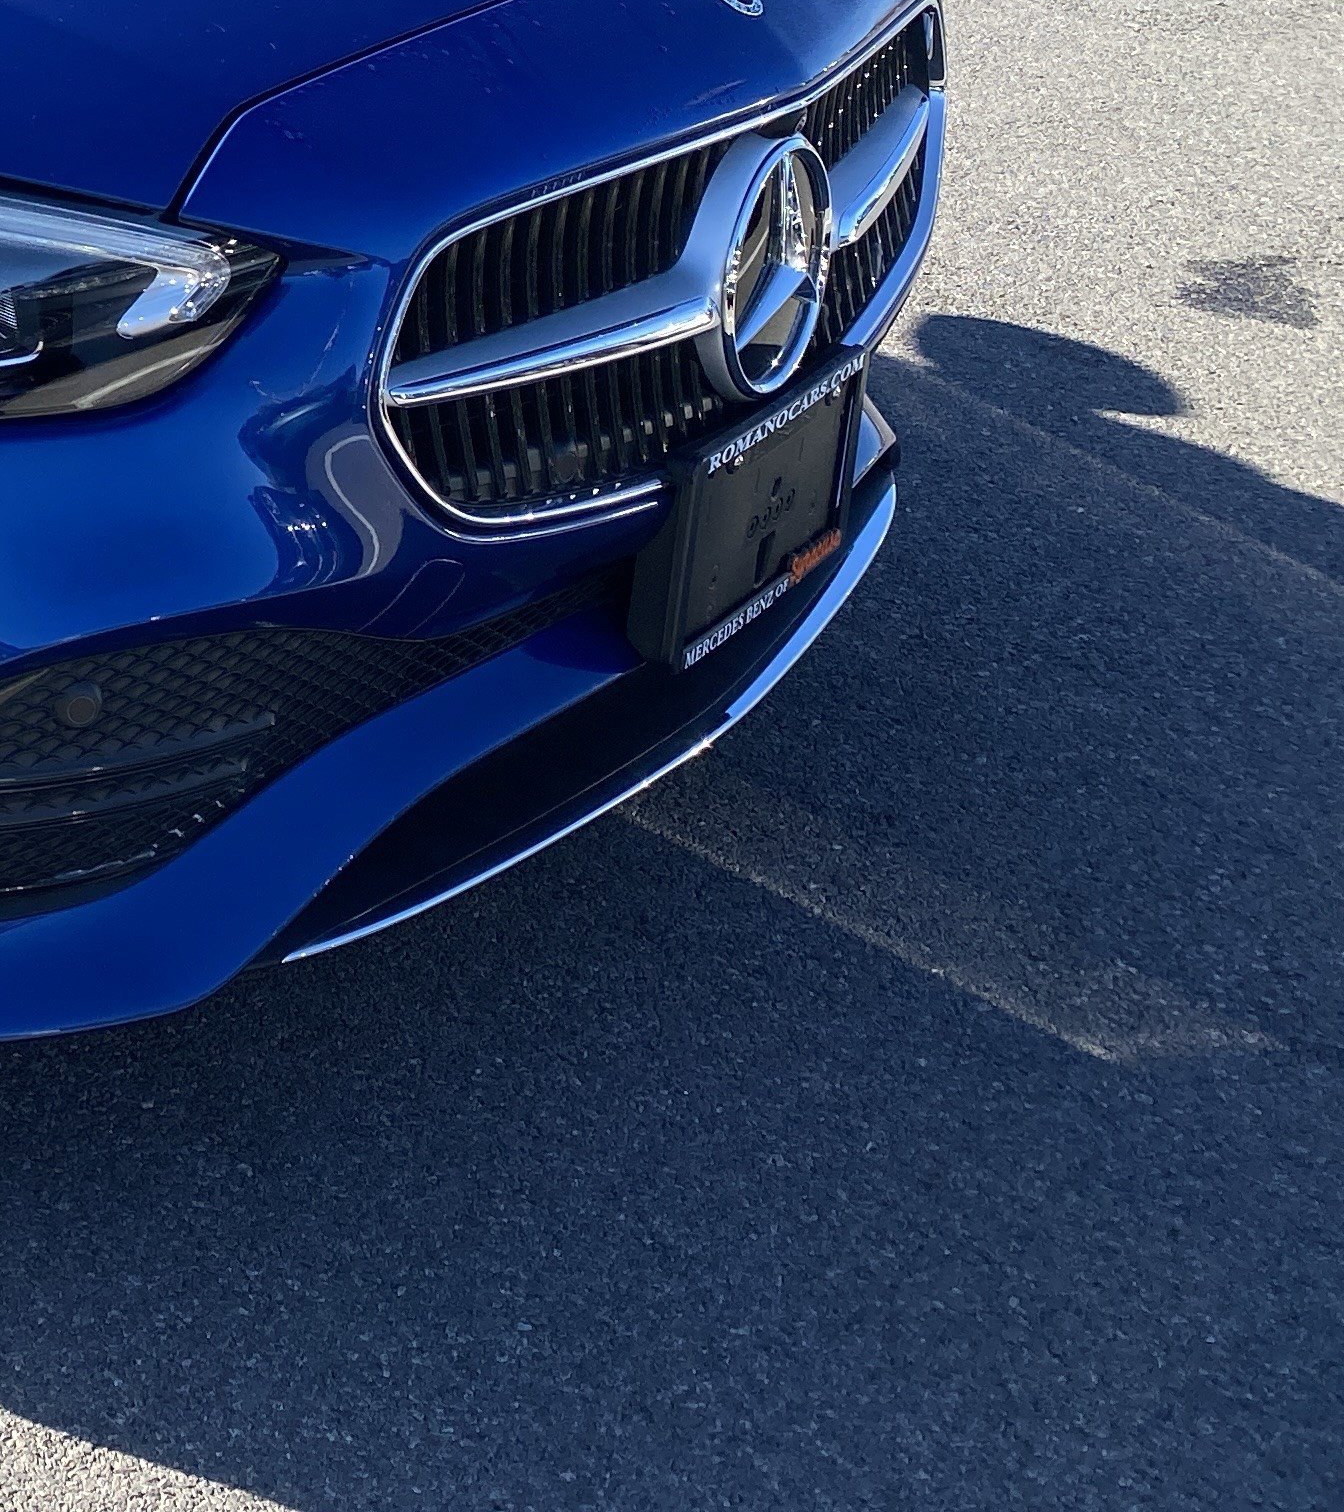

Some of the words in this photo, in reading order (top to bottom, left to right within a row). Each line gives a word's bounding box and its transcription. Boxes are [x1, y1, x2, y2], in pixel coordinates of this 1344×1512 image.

[707, 352, 866, 475] ROMANOCARS.COM
[684, 612, 745, 670] MERCEDES
[745, 590, 774, 625] BENZ
